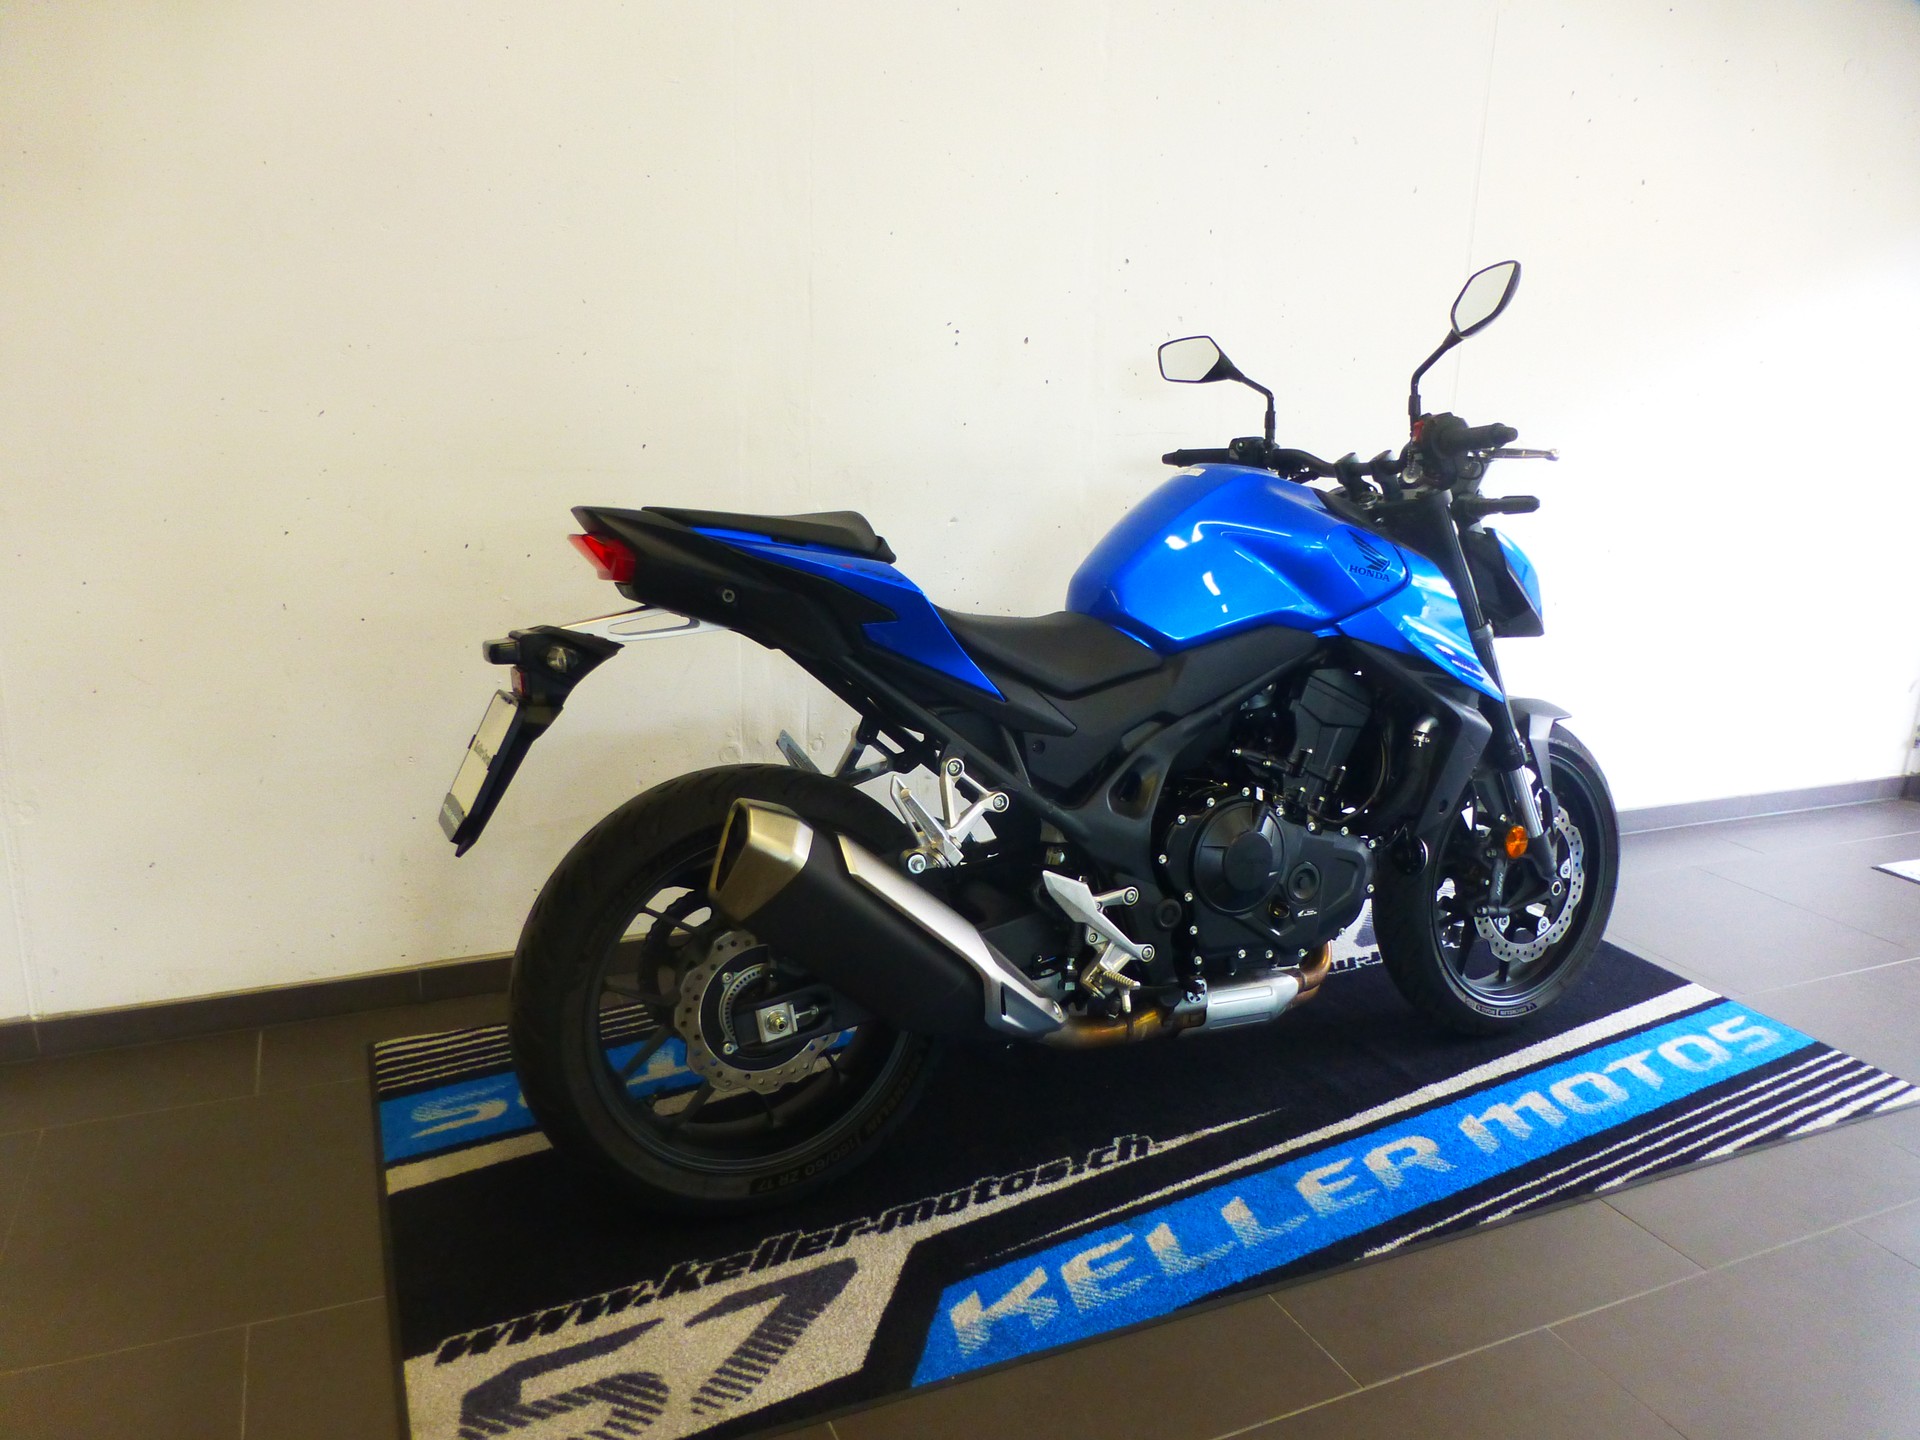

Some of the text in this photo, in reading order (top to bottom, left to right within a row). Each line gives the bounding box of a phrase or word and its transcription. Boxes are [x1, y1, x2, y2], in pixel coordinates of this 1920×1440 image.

[1348, 565, 1390, 582] HONDA
[803, 1139, 858, 1176] 160/60
[757, 1177, 774, 1191] 17
[779, 1169, 800, 1187] ZR
[949, 1015, 1782, 1357] KELLER MOTOS
[434, 1133, 1155, 1367] www.keller-motos.ch
